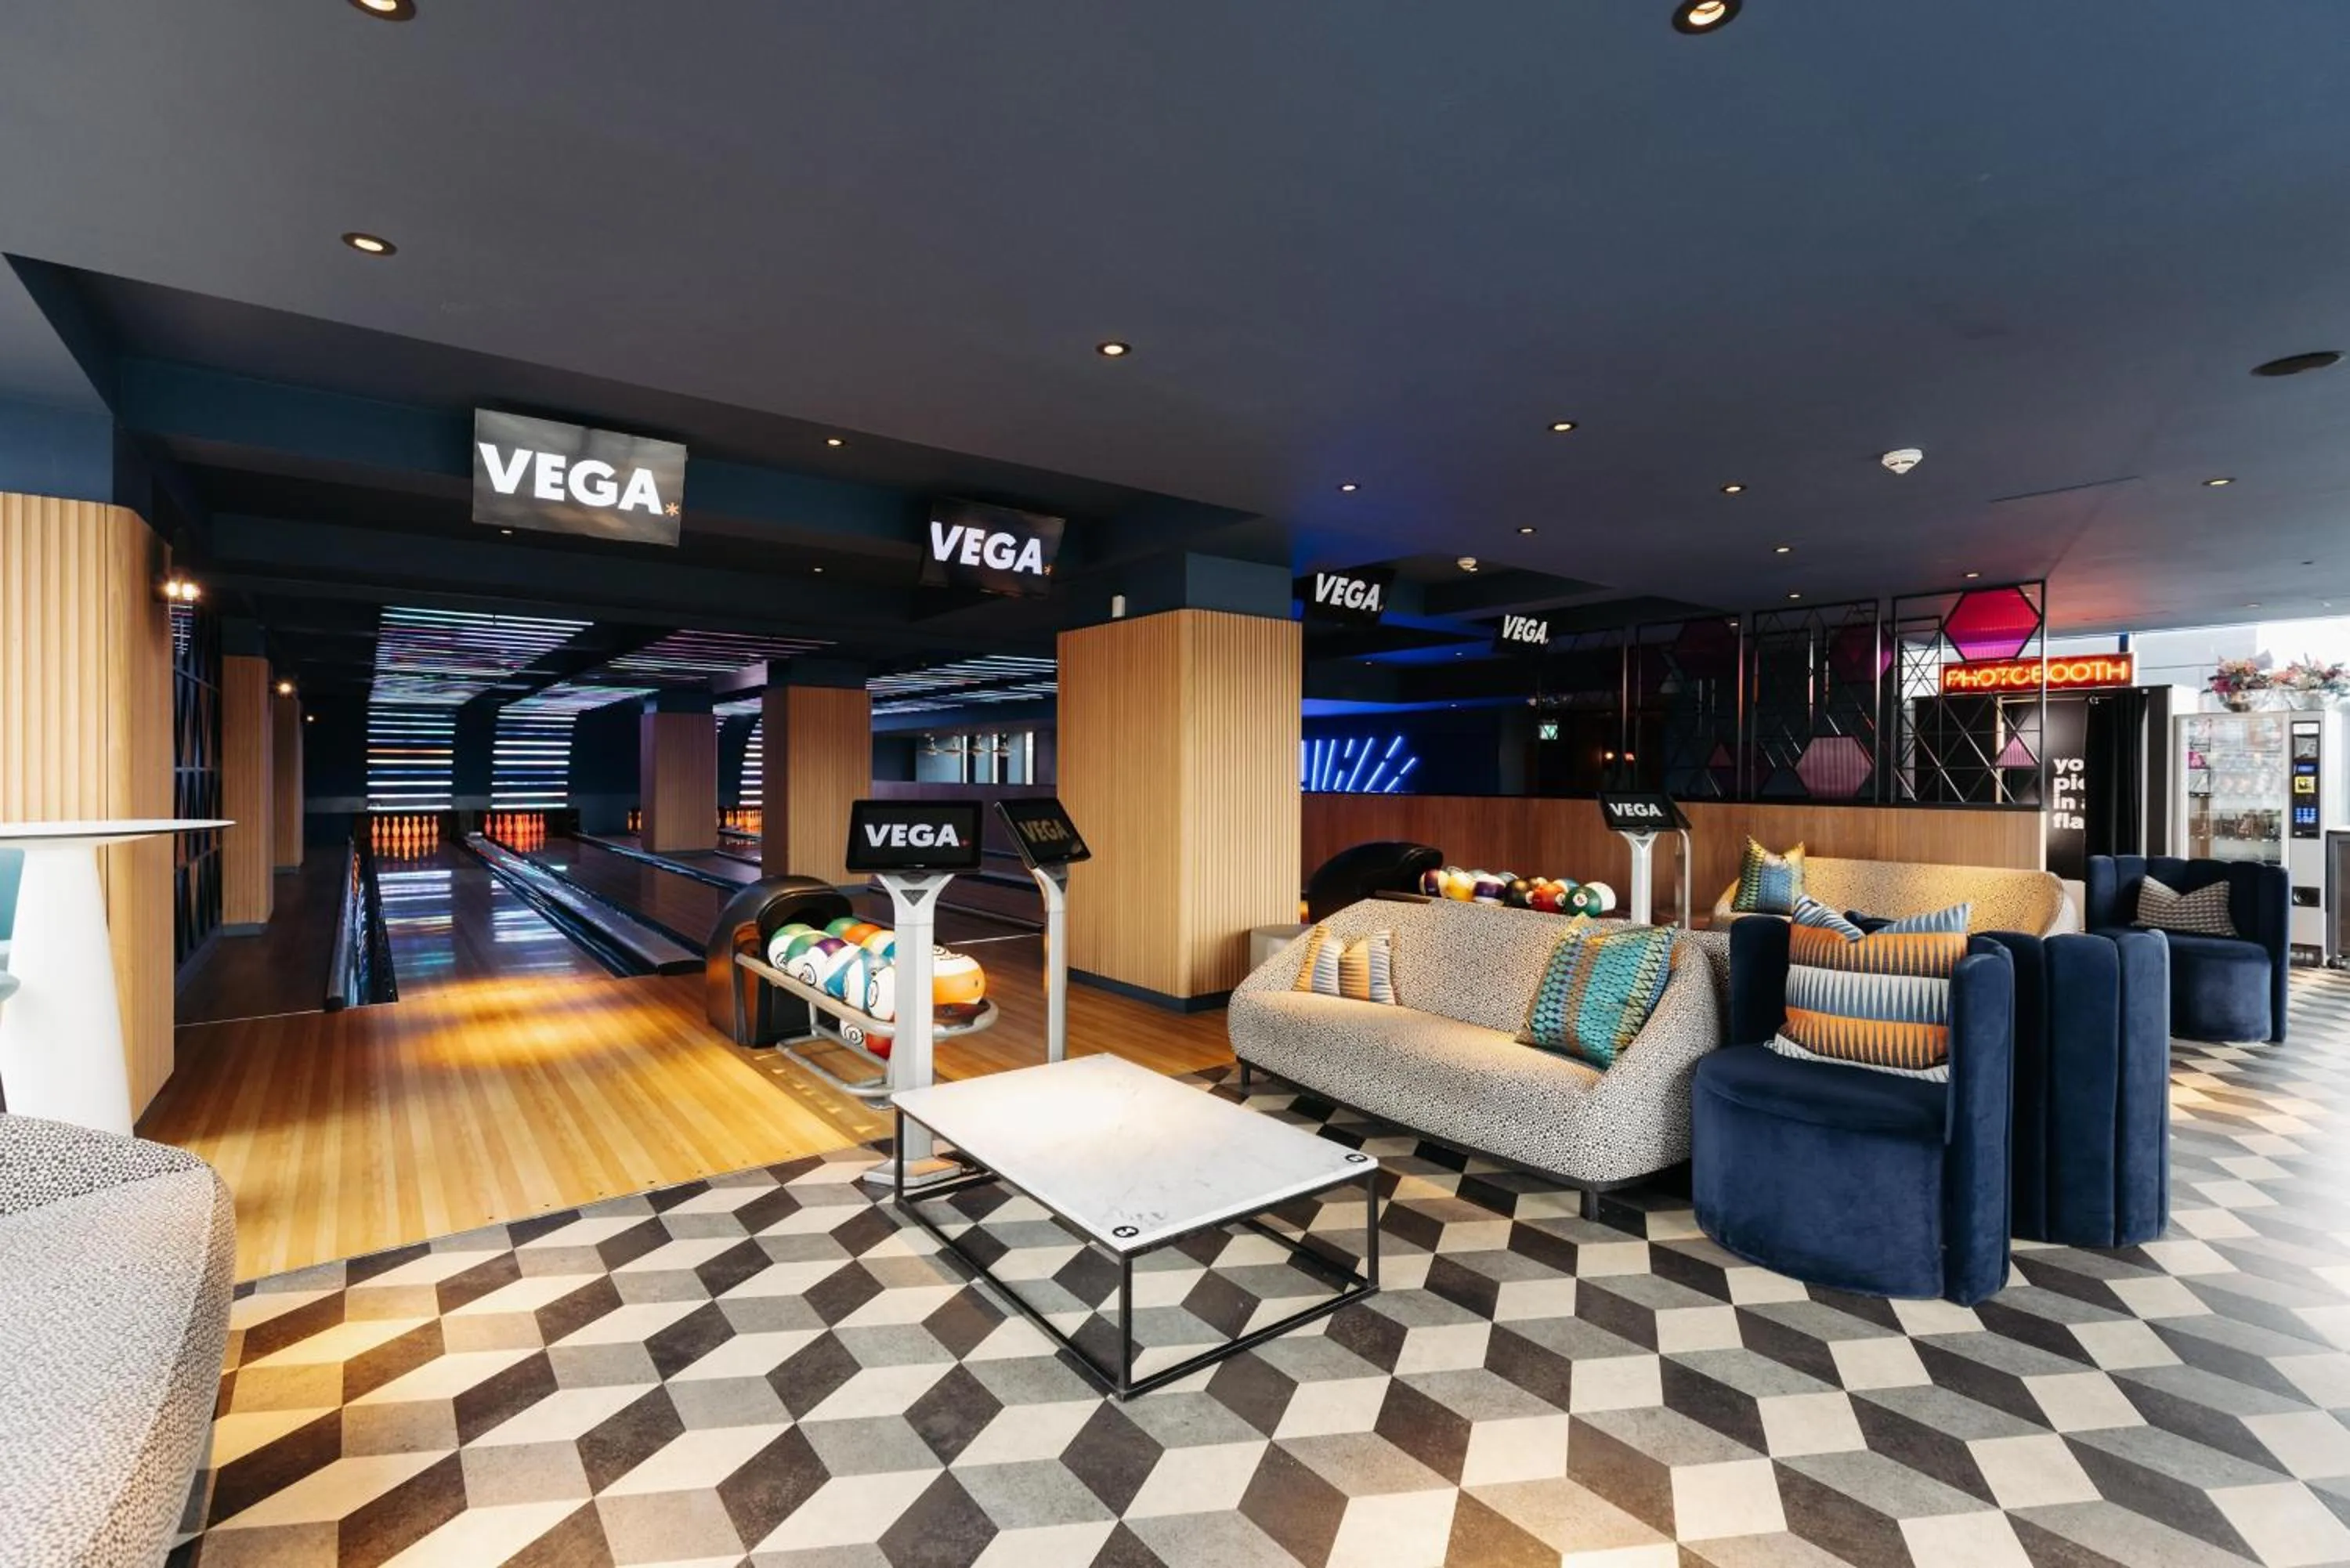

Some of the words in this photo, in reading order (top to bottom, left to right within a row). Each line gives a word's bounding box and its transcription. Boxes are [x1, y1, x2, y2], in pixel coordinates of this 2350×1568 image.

[479, 443, 663, 515] VEGA
[931, 521, 1043, 575] VEGA
[1315, 573, 1380, 611] VEGA
[1502, 614, 1547, 644] VEGA
[1608, 803, 1663, 817] VEGA
[864, 824, 960, 847] VEGA
[1018, 819, 1070, 843] VEGA
